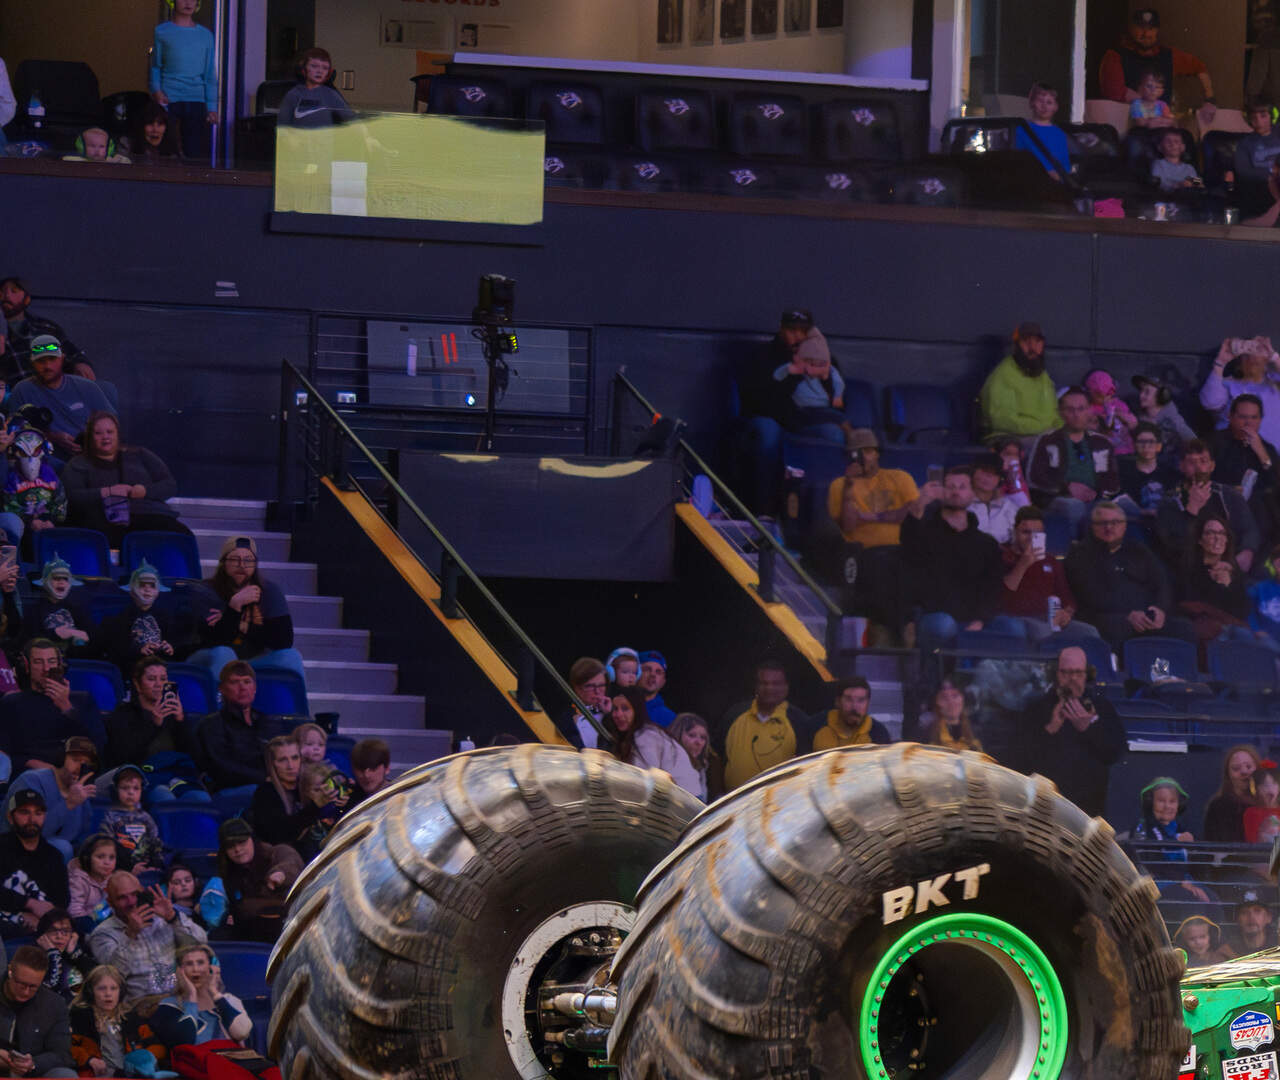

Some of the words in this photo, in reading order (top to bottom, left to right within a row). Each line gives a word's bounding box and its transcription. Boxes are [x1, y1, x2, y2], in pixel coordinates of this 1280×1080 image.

[883, 863, 990, 925] BKT
[1234, 1025, 1267, 1040] LUCAS
[1226, 1053, 1273, 1067] ENDS
[1227, 1062, 1263, 1074] ROD
